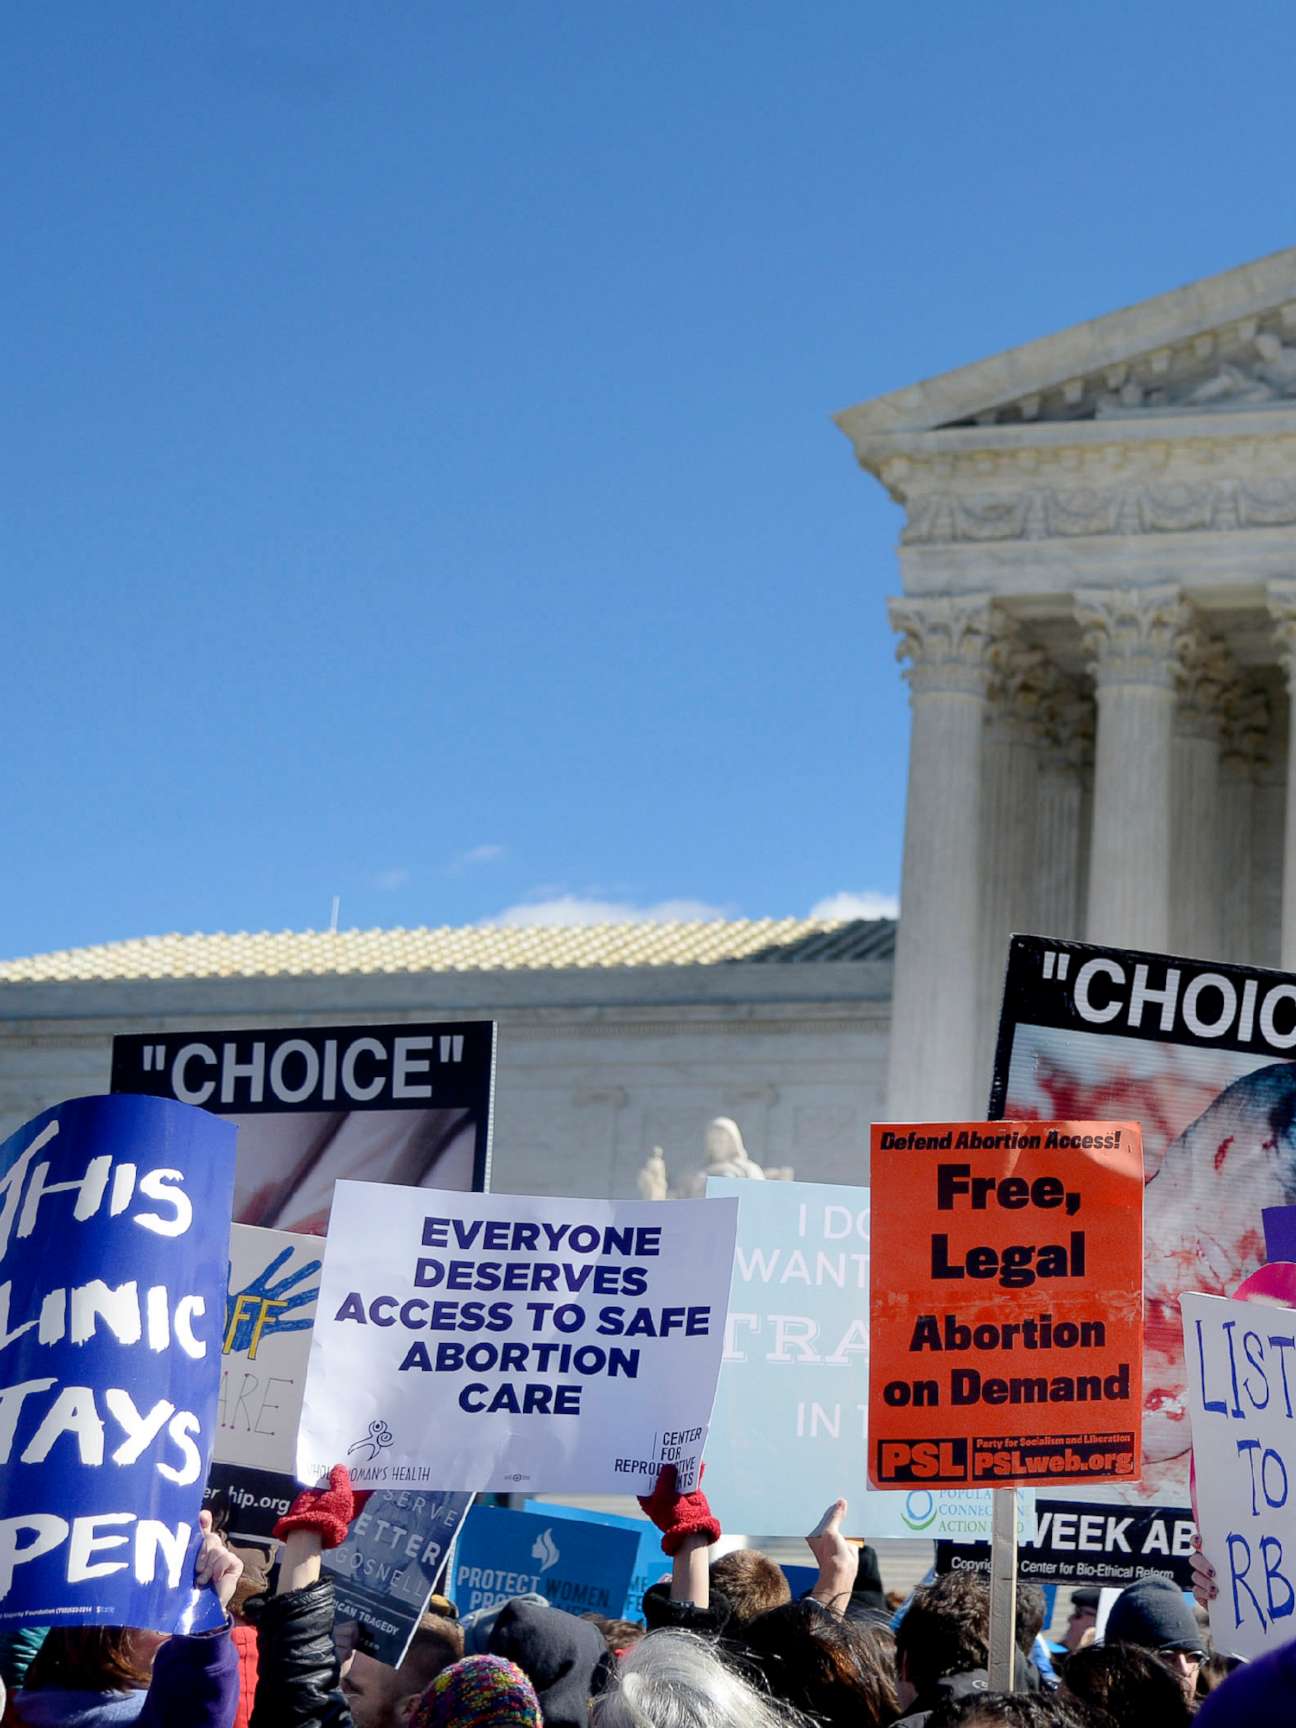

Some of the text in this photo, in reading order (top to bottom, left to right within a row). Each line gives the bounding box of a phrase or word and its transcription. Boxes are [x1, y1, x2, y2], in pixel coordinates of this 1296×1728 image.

[141, 1035, 463, 1104] "CHOICE"
[880, 1131, 1121, 1150] Defend Abortion Access!
[936, 1165, 1082, 1216] Free,
[421, 1217, 661, 1257] EVERYONE
[800, 1204, 806, 1237] I
[414, 1258, 647, 1296] DESERVES
[930, 1230, 1086, 1290] Legal
[0, 1280, 206, 1358] LINIC
[334, 1293, 711, 1338] ACCESS TO SAFE
[910, 1315, 1106, 1352] Abortion
[397, 1341, 640, 1378] ABORTION
[459, 1384, 582, 1417] CARE
[883, 1365, 1131, 1407] on Demand
[0, 1378, 201, 1487] TAYS
[663, 1427, 702, 1446] CENTER
[796, 1402, 840, 1439] IN
[661, 1447, 681, 1461] FOR
[881, 1442, 965, 1478] PSL
[976, 1434, 1131, 1449] Party for Socialism and Liberation
[392, 1466, 431, 1481] HEALTH
[975, 1449, 1133, 1476] PSLweb.org
[1236, 1439, 1288, 1516] TO
[354, 1513, 441, 1566] ETTER
[939, 1521, 985, 1532] ACTION
[0, 1513, 192, 1602] PEN
[336, 1549, 425, 1596] GOSNELL
[1020, 1561, 1057, 1574] Center
[1059, 1562, 1074, 1575] for
[1077, 1563, 1133, 1578] Bio-Ethical
[457, 1566, 540, 1593] PROTECT
[546, 1578, 610, 1607] WOMEN
[359, 1611, 400, 1635] TRAGEDY
